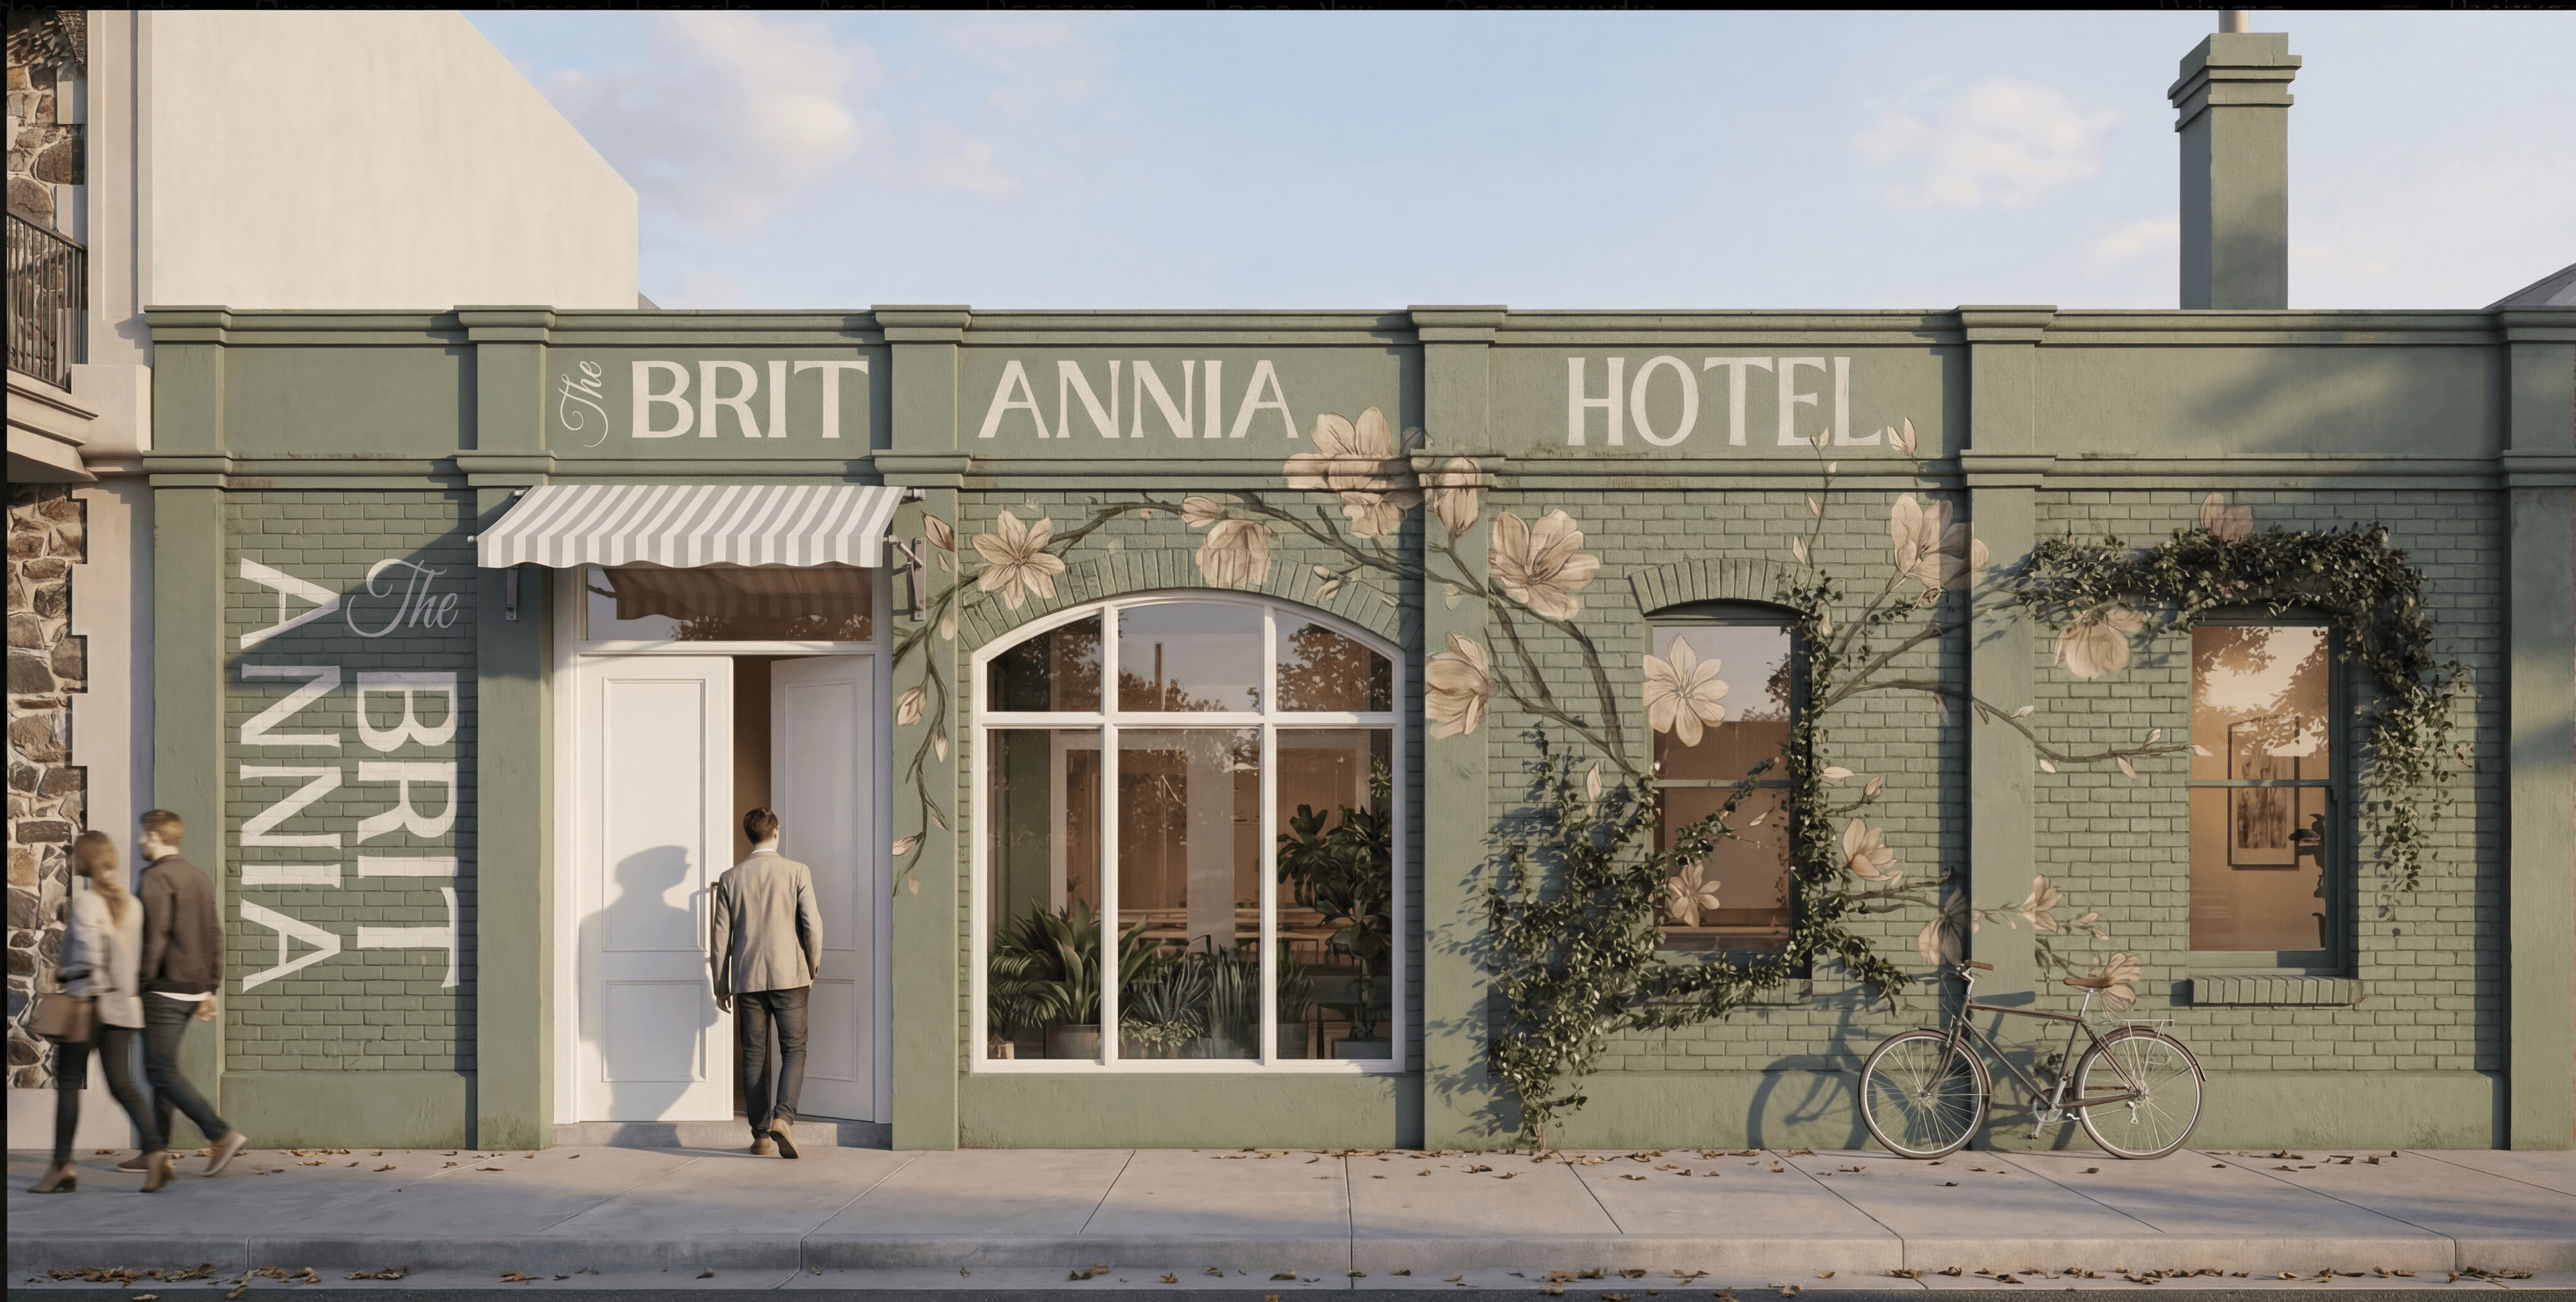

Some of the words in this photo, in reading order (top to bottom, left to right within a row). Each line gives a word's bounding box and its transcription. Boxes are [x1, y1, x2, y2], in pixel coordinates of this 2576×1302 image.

[558, 360, 609, 448] The
[631, 360, 869, 439] BRIT
[977, 360, 1299, 439] ANNIA
[1567, 355, 1882, 447] HOTEL
[346, 558, 459, 638] The
[239, 557, 342, 994] ANNIA
[356, 671, 460, 988] BRIT
